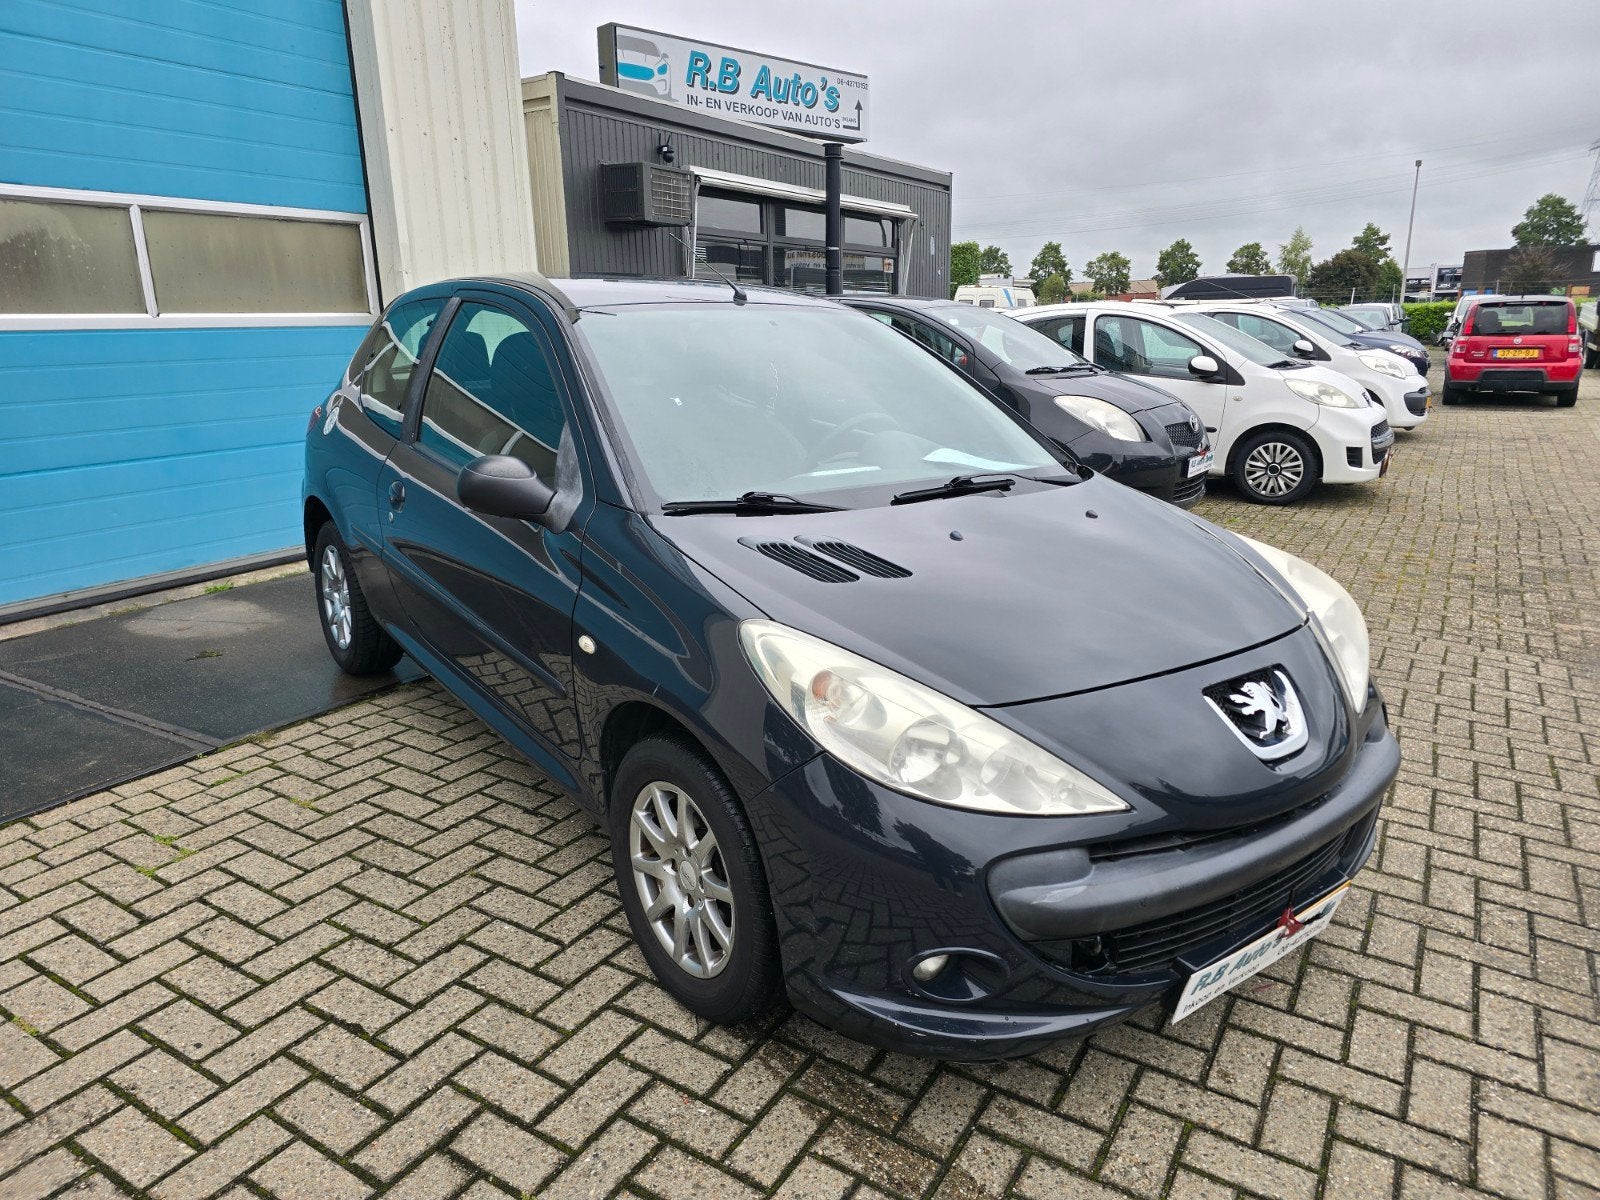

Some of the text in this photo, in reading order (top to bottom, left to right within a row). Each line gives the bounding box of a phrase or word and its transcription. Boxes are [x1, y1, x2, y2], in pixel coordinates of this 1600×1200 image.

[686, 50, 841, 113] R.B Auto's
[686, 94, 841, 129] IN- EN VERKOOP VAN AUTO'S
